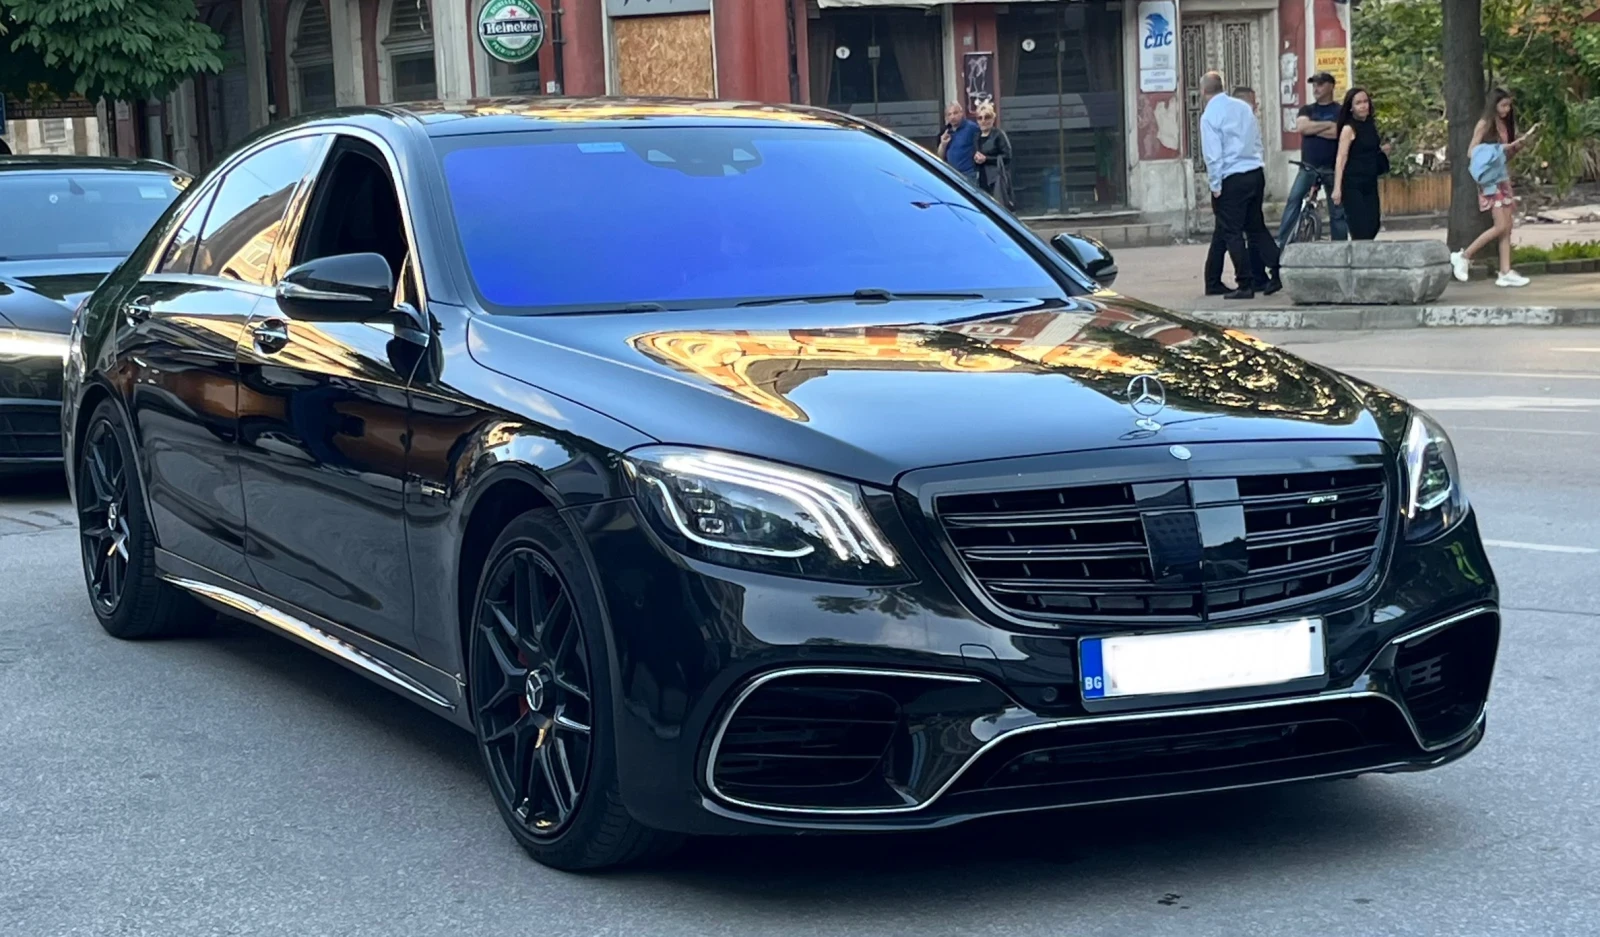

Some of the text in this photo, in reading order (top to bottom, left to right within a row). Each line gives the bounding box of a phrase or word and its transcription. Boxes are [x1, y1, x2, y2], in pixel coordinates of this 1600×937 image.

[486, 21, 538, 34] Heineken
[1144, 31, 1173, 49] СДС
[1085, 676, 1102, 690] BG
